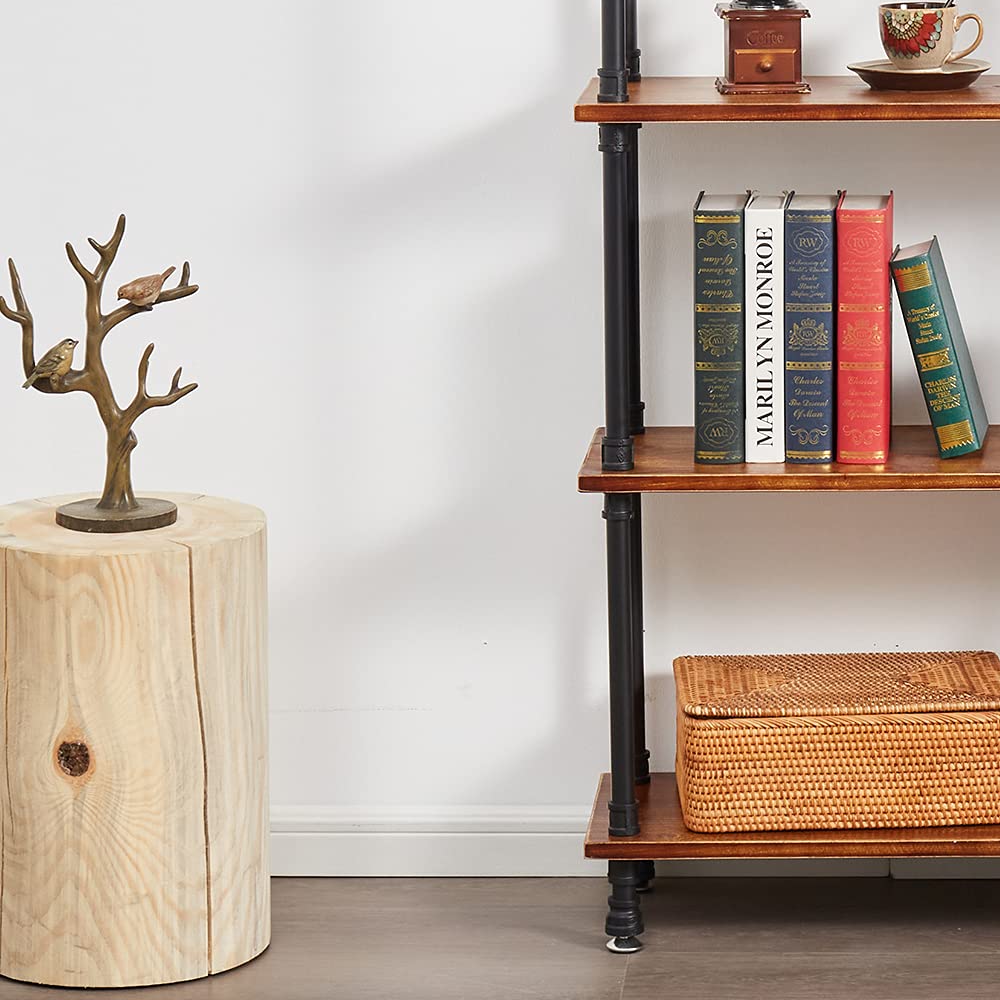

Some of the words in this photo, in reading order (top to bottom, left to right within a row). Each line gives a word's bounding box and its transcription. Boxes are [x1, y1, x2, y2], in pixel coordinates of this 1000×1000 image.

[798, 237, 819, 248] RW
[755, 227, 773, 330] MONROE
[756, 336, 774, 447] MARILYN
[793, 375, 824, 385] Charles
